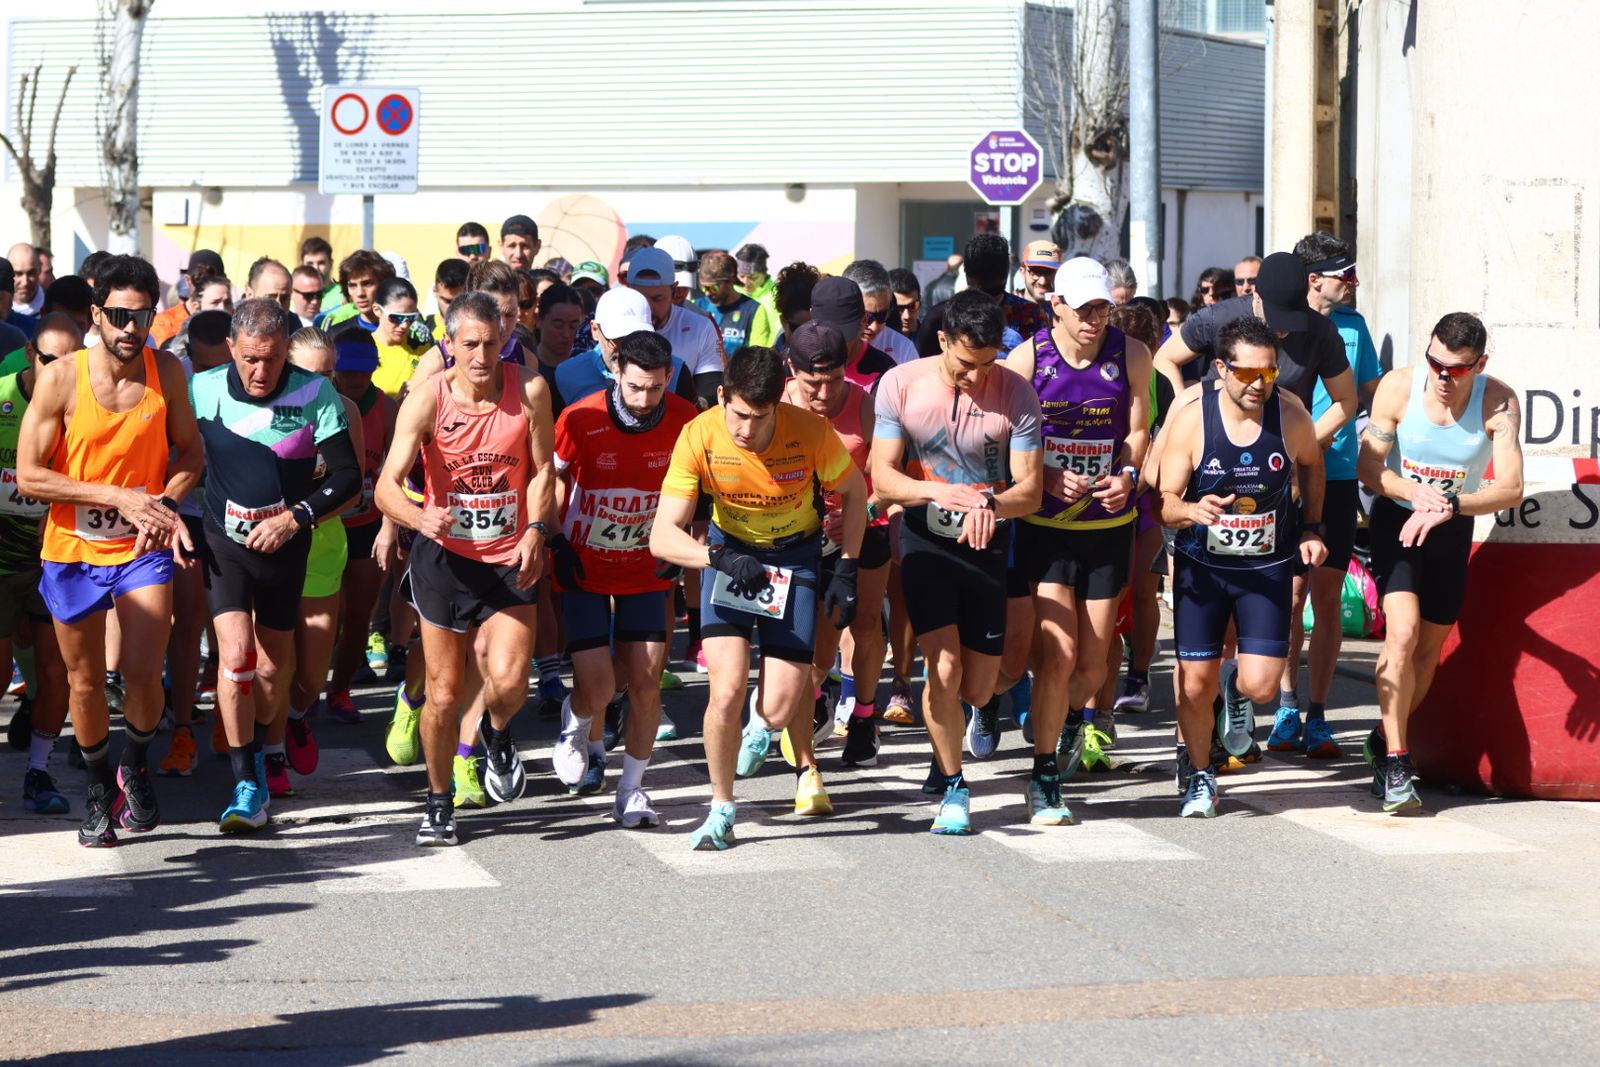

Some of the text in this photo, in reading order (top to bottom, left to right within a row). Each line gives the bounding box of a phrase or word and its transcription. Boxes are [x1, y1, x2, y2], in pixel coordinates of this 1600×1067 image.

[974, 152, 1037, 173] STOP
[982, 174, 1028, 186] Violencia
[722, 327, 746, 340] EDA
[1046, 439, 1112, 455] bedunia
[462, 455, 475, 465] LA
[478, 453, 519, 467] ESCAPAD
[1056, 454, 1101, 477] 355
[472, 466, 493, 475] RUN
[472, 476, 493, 488] CLUB
[449, 495, 517, 509] bedunia
[581, 491, 660, 518] MARAT
[460, 508, 507, 530] 354
[601, 523, 645, 541] 414
[1219, 528, 1265, 547] 392
